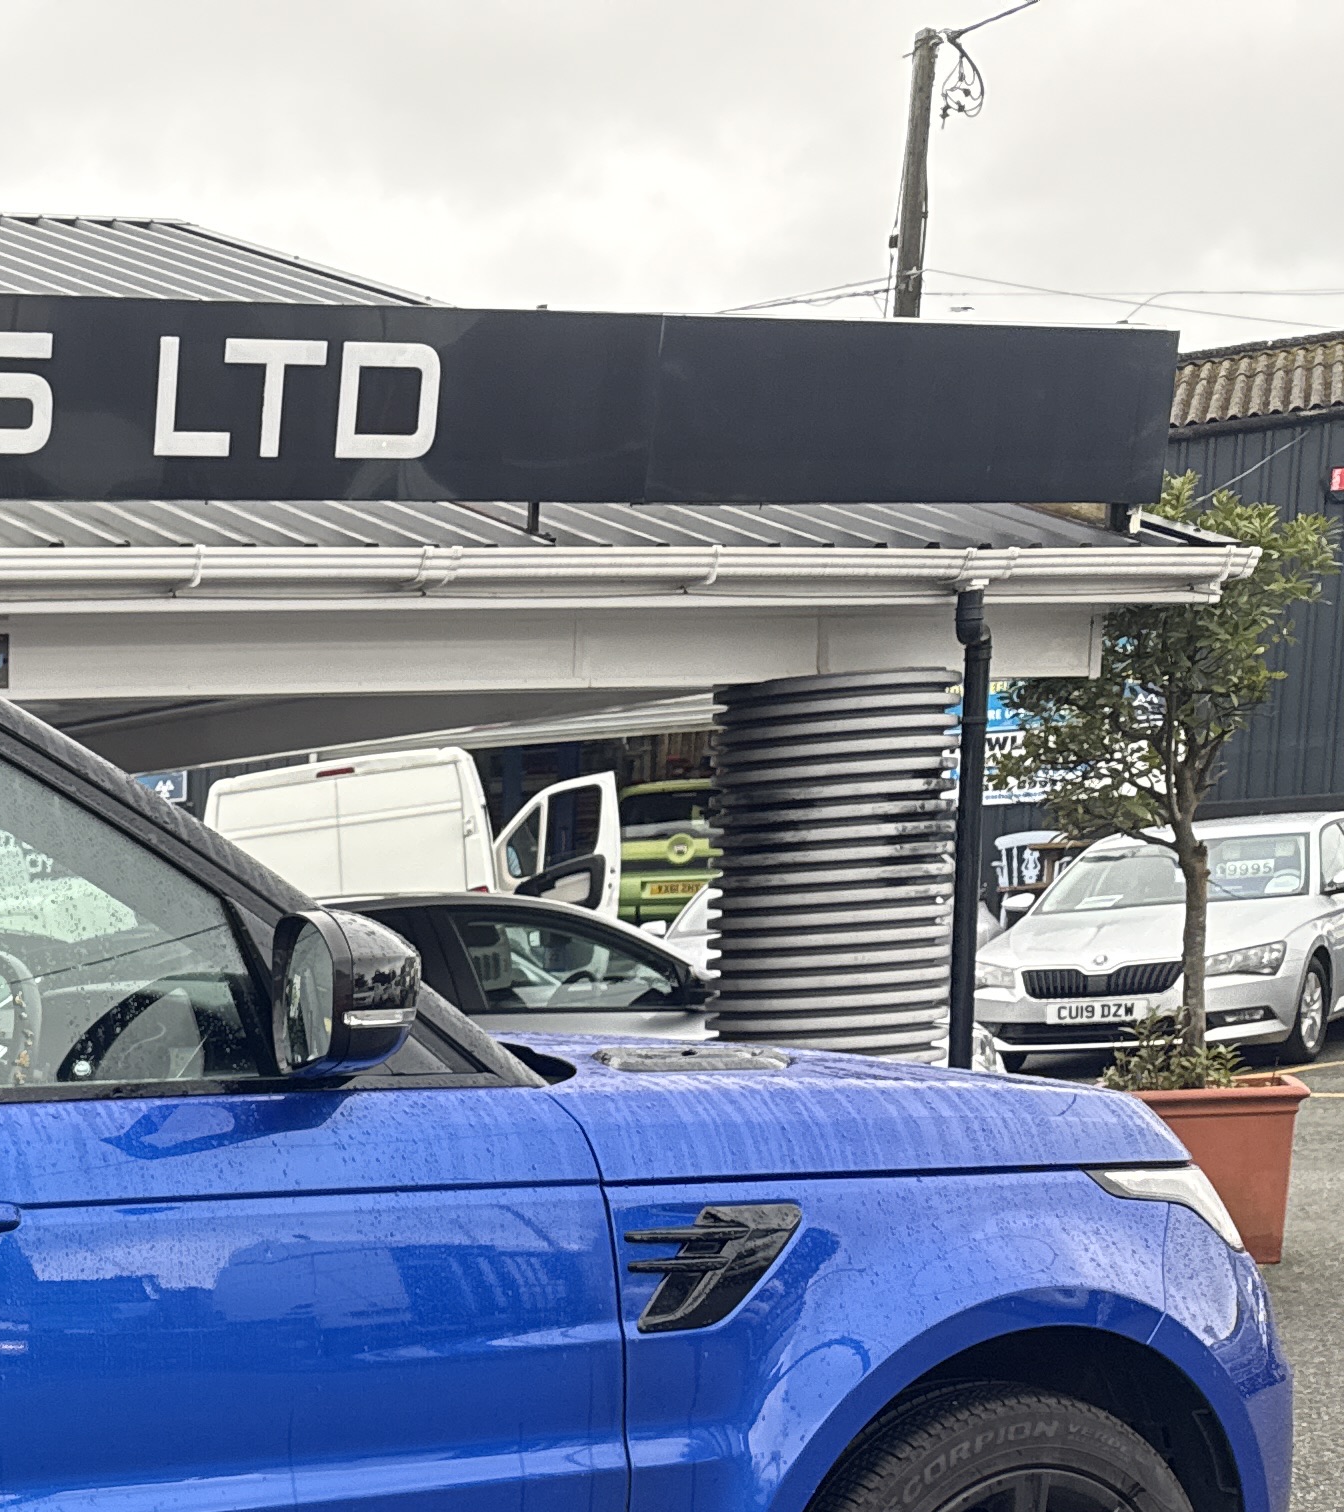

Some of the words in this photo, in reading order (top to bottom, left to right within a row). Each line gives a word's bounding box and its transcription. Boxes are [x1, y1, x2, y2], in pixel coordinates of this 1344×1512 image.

[154, 336, 440, 458] LTD
[1057, 1005, 1095, 1020] CU19
[1101, 1003, 1135, 1018] DZW
